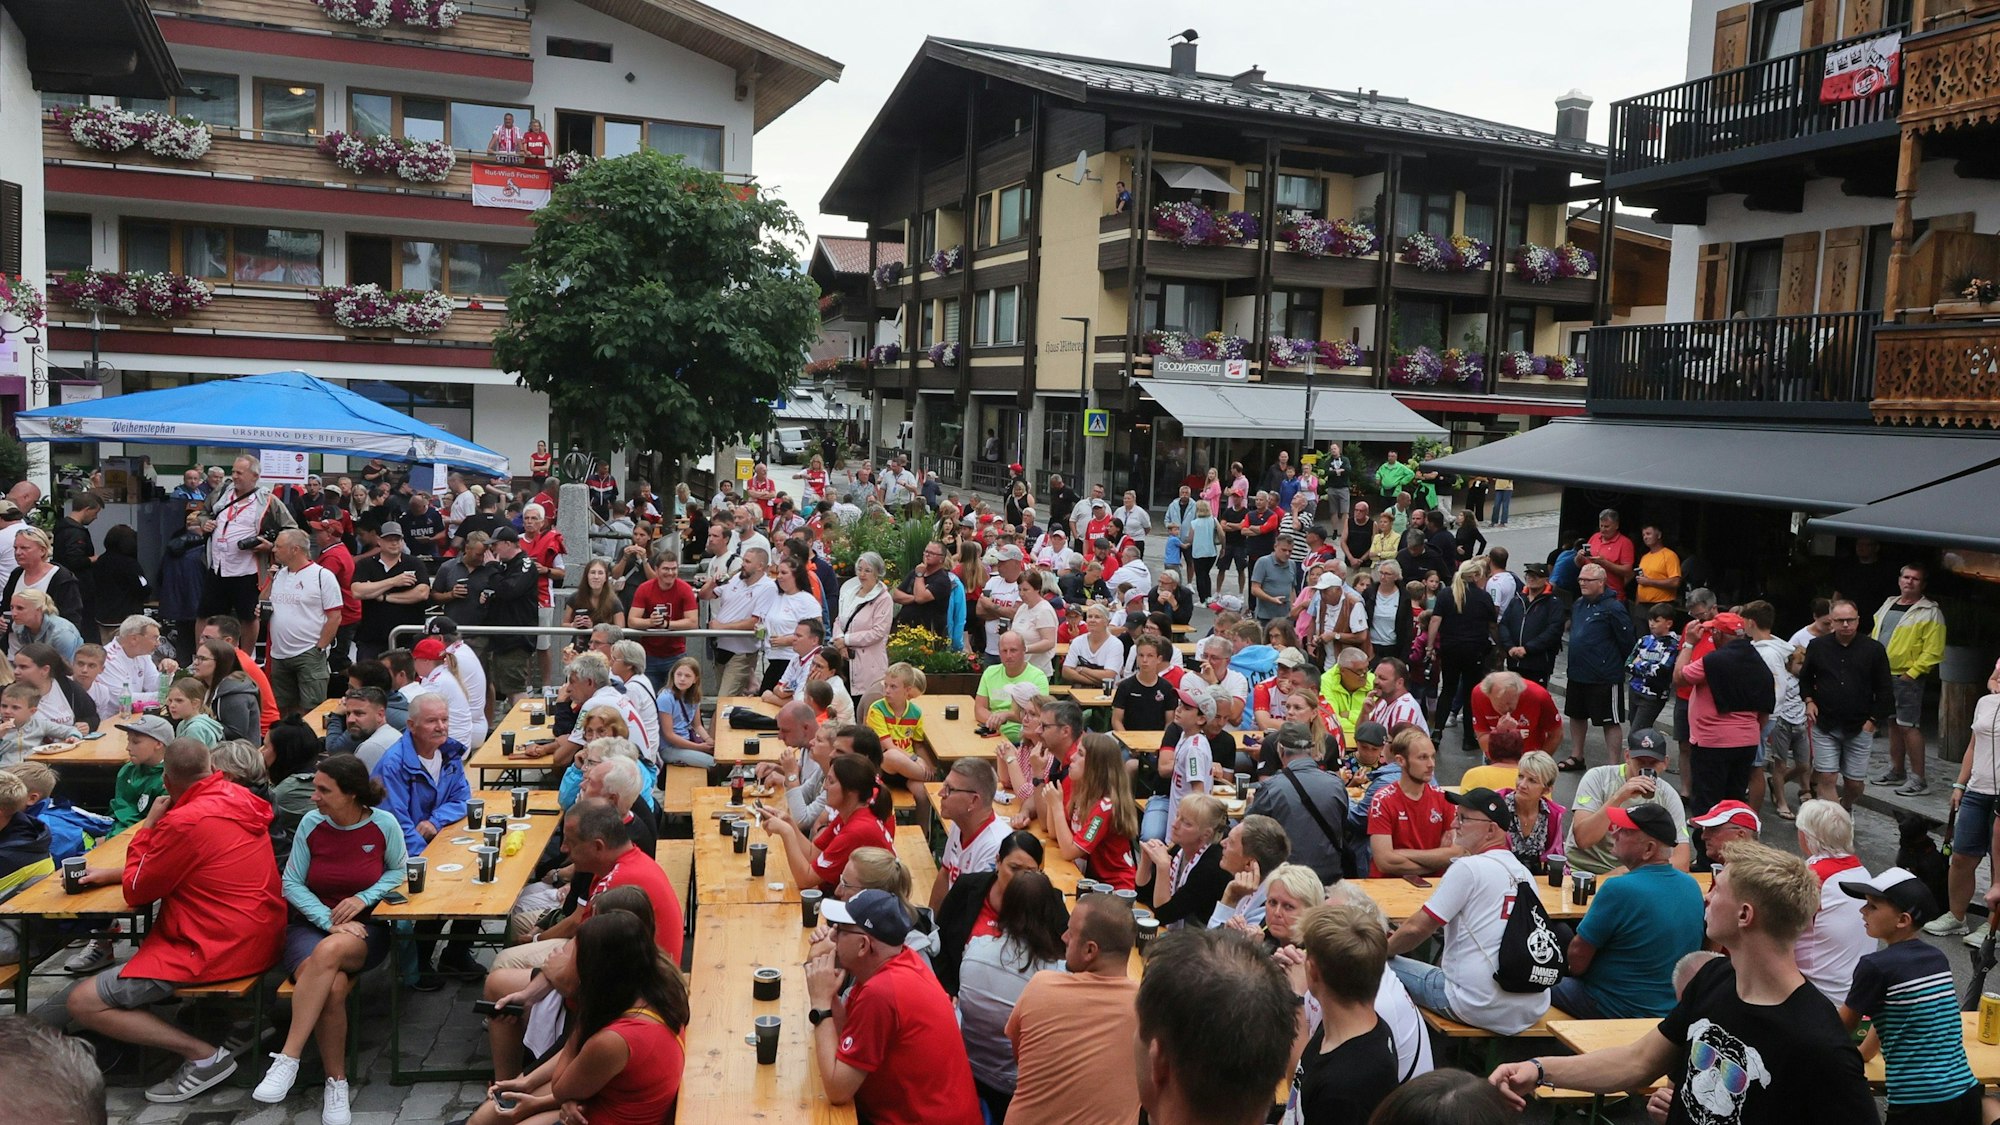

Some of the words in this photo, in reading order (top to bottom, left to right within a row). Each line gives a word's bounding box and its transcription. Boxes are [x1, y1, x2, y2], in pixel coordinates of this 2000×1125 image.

[1158, 362, 1221, 373] FOODWERKSTATT
[112, 421, 176, 435] Weihenstephan
[232, 428, 289, 438] URSPRUNG
[294, 432, 314, 441] DES
[318, 434, 355, 444] BIERES
[410, 527, 434, 536] REWE
[1086, 818, 1101, 840] DEVK
[1531, 965, 1559, 978] IMMER
[1528, 974, 1557, 985] DABEI
